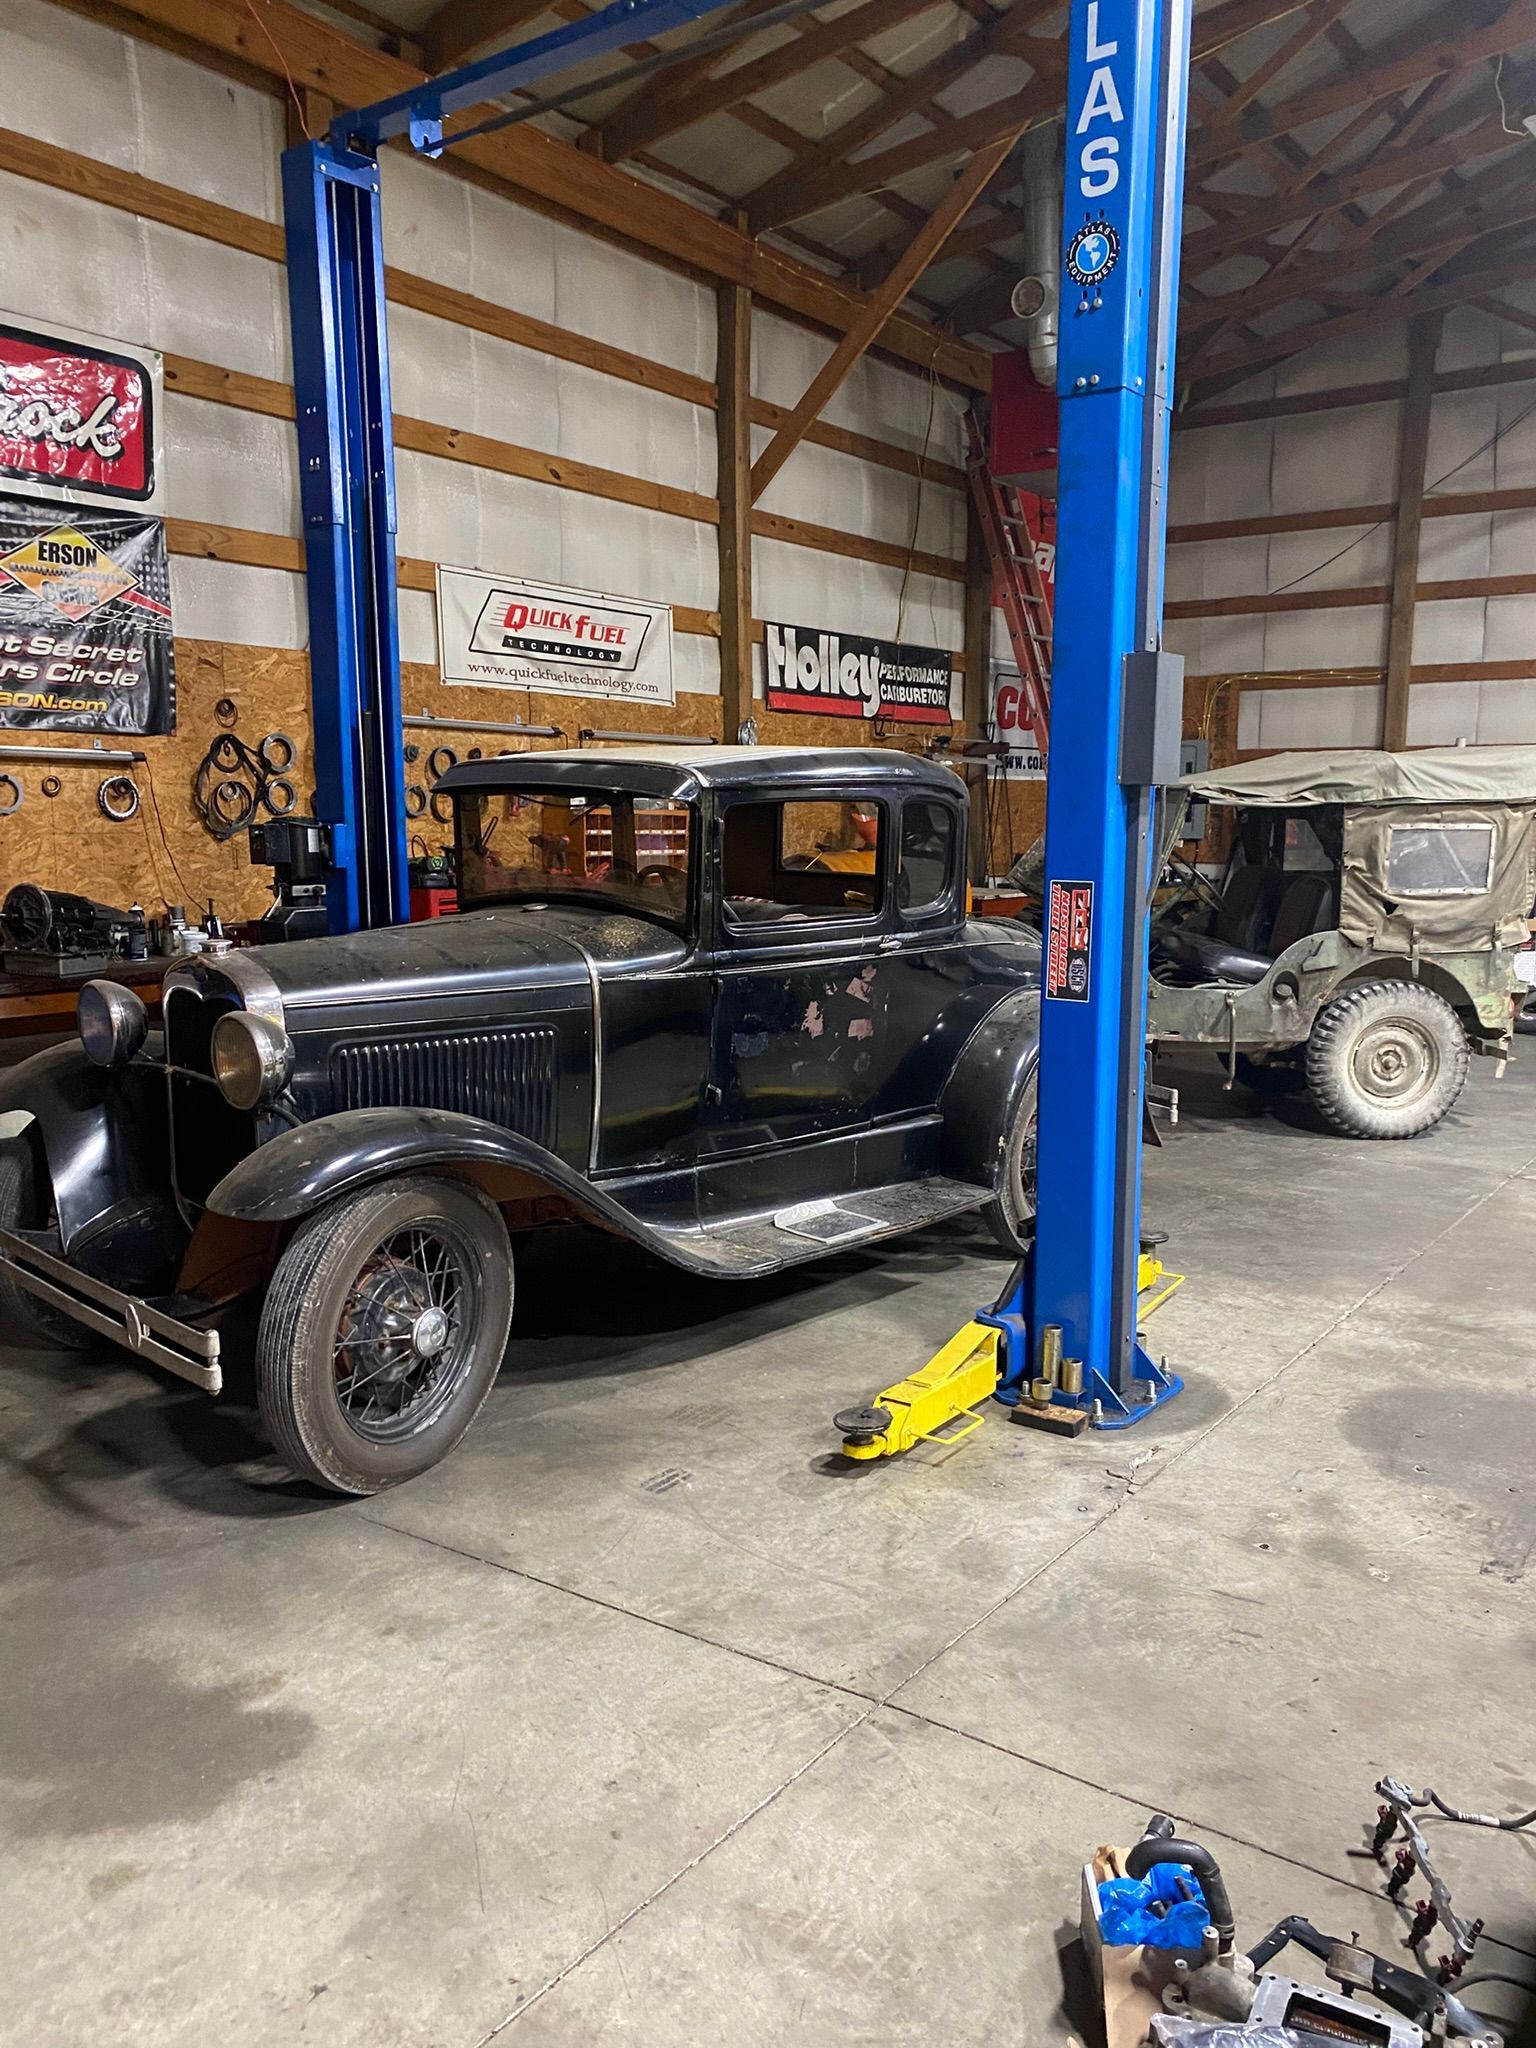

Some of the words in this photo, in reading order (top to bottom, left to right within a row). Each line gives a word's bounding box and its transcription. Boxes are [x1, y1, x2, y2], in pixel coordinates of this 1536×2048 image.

[1077, 224, 1111, 242] ATLAS
[1068, 252, 1117, 283] EQUIPMENT
[38, 540, 97, 567] ERSON
[27, 636, 143, 663] Secret
[508, 639, 615, 660] TECHNOLOGY
[46, 662, 139, 687] Circle
[468, 664, 659, 693] www.quickfueltechnology.com
[767, 624, 880, 718] Holley
[879, 663, 948, 686] PERFORMANCE
[1051, 884, 1061, 930] TRUE
[1058, 890, 1070, 988] NOSTALGIA
[1048, 930, 1059, 996] STREET
